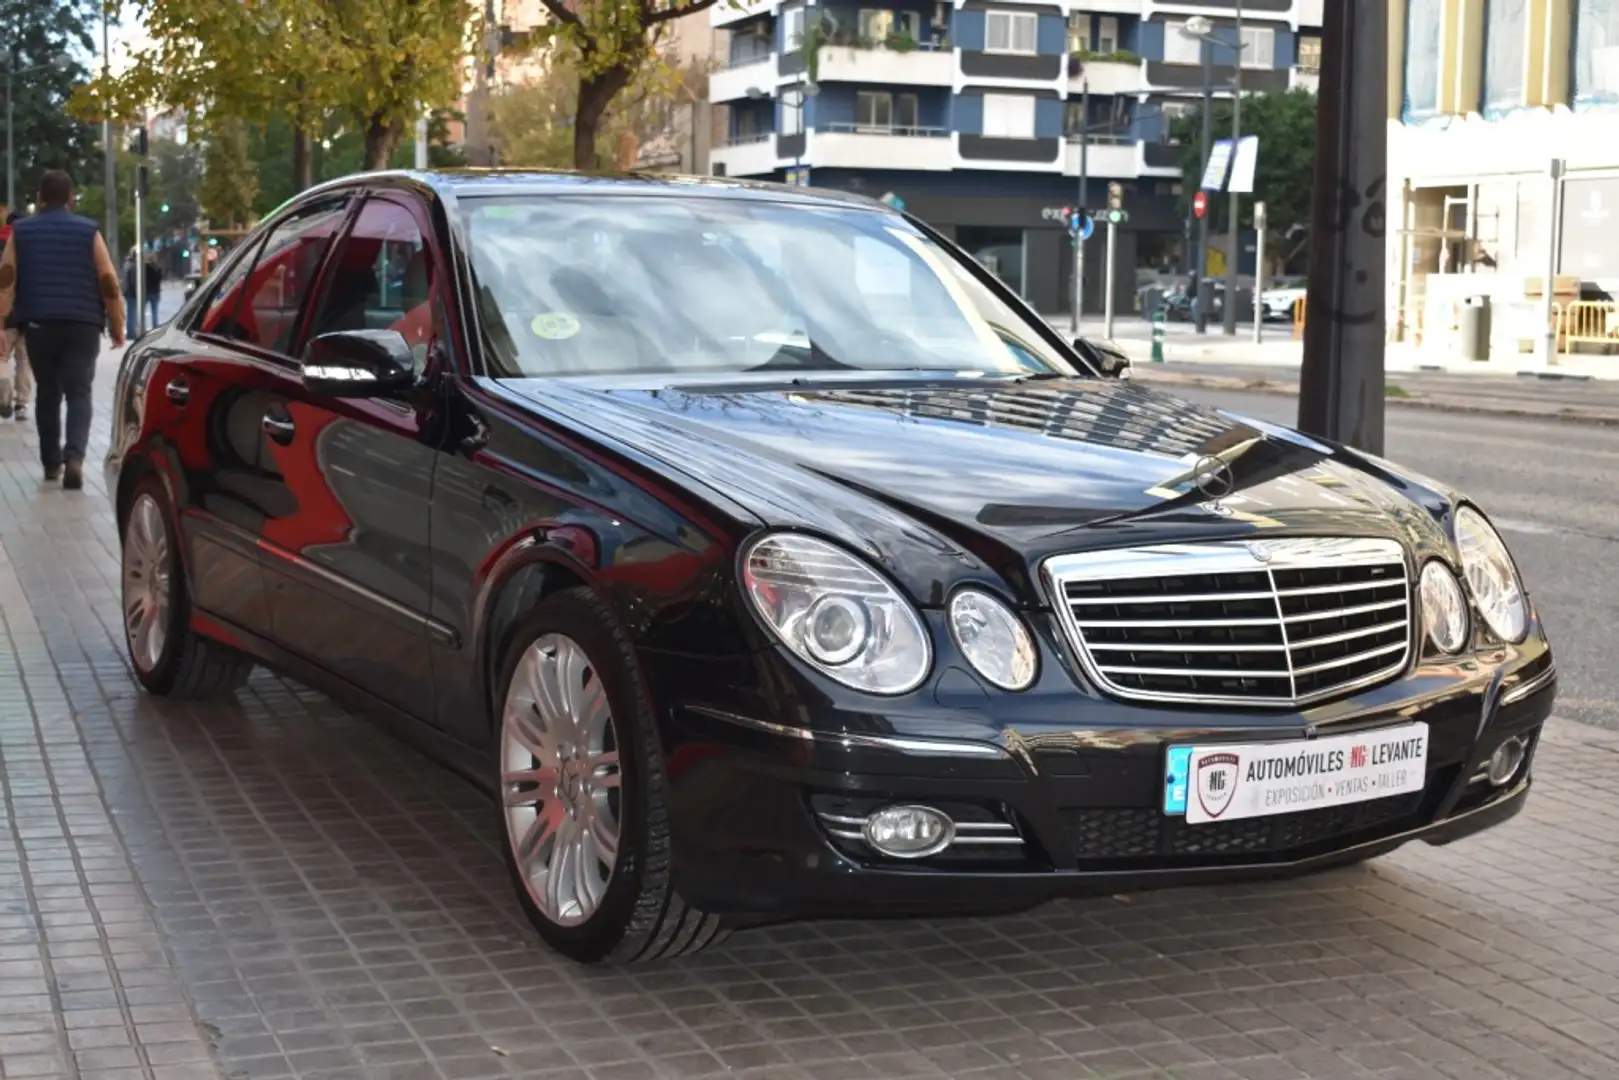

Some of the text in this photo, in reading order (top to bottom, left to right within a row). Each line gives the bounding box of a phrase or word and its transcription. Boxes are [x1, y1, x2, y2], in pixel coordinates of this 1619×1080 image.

[1245, 749, 1344, 783] AUTOMÓVILES
[1372, 737, 1423, 765] LEVANTE
[1209, 769, 1226, 792] NG
[1264, 769, 1407, 807] EXPOSICIÓN VENTAS TALLER
